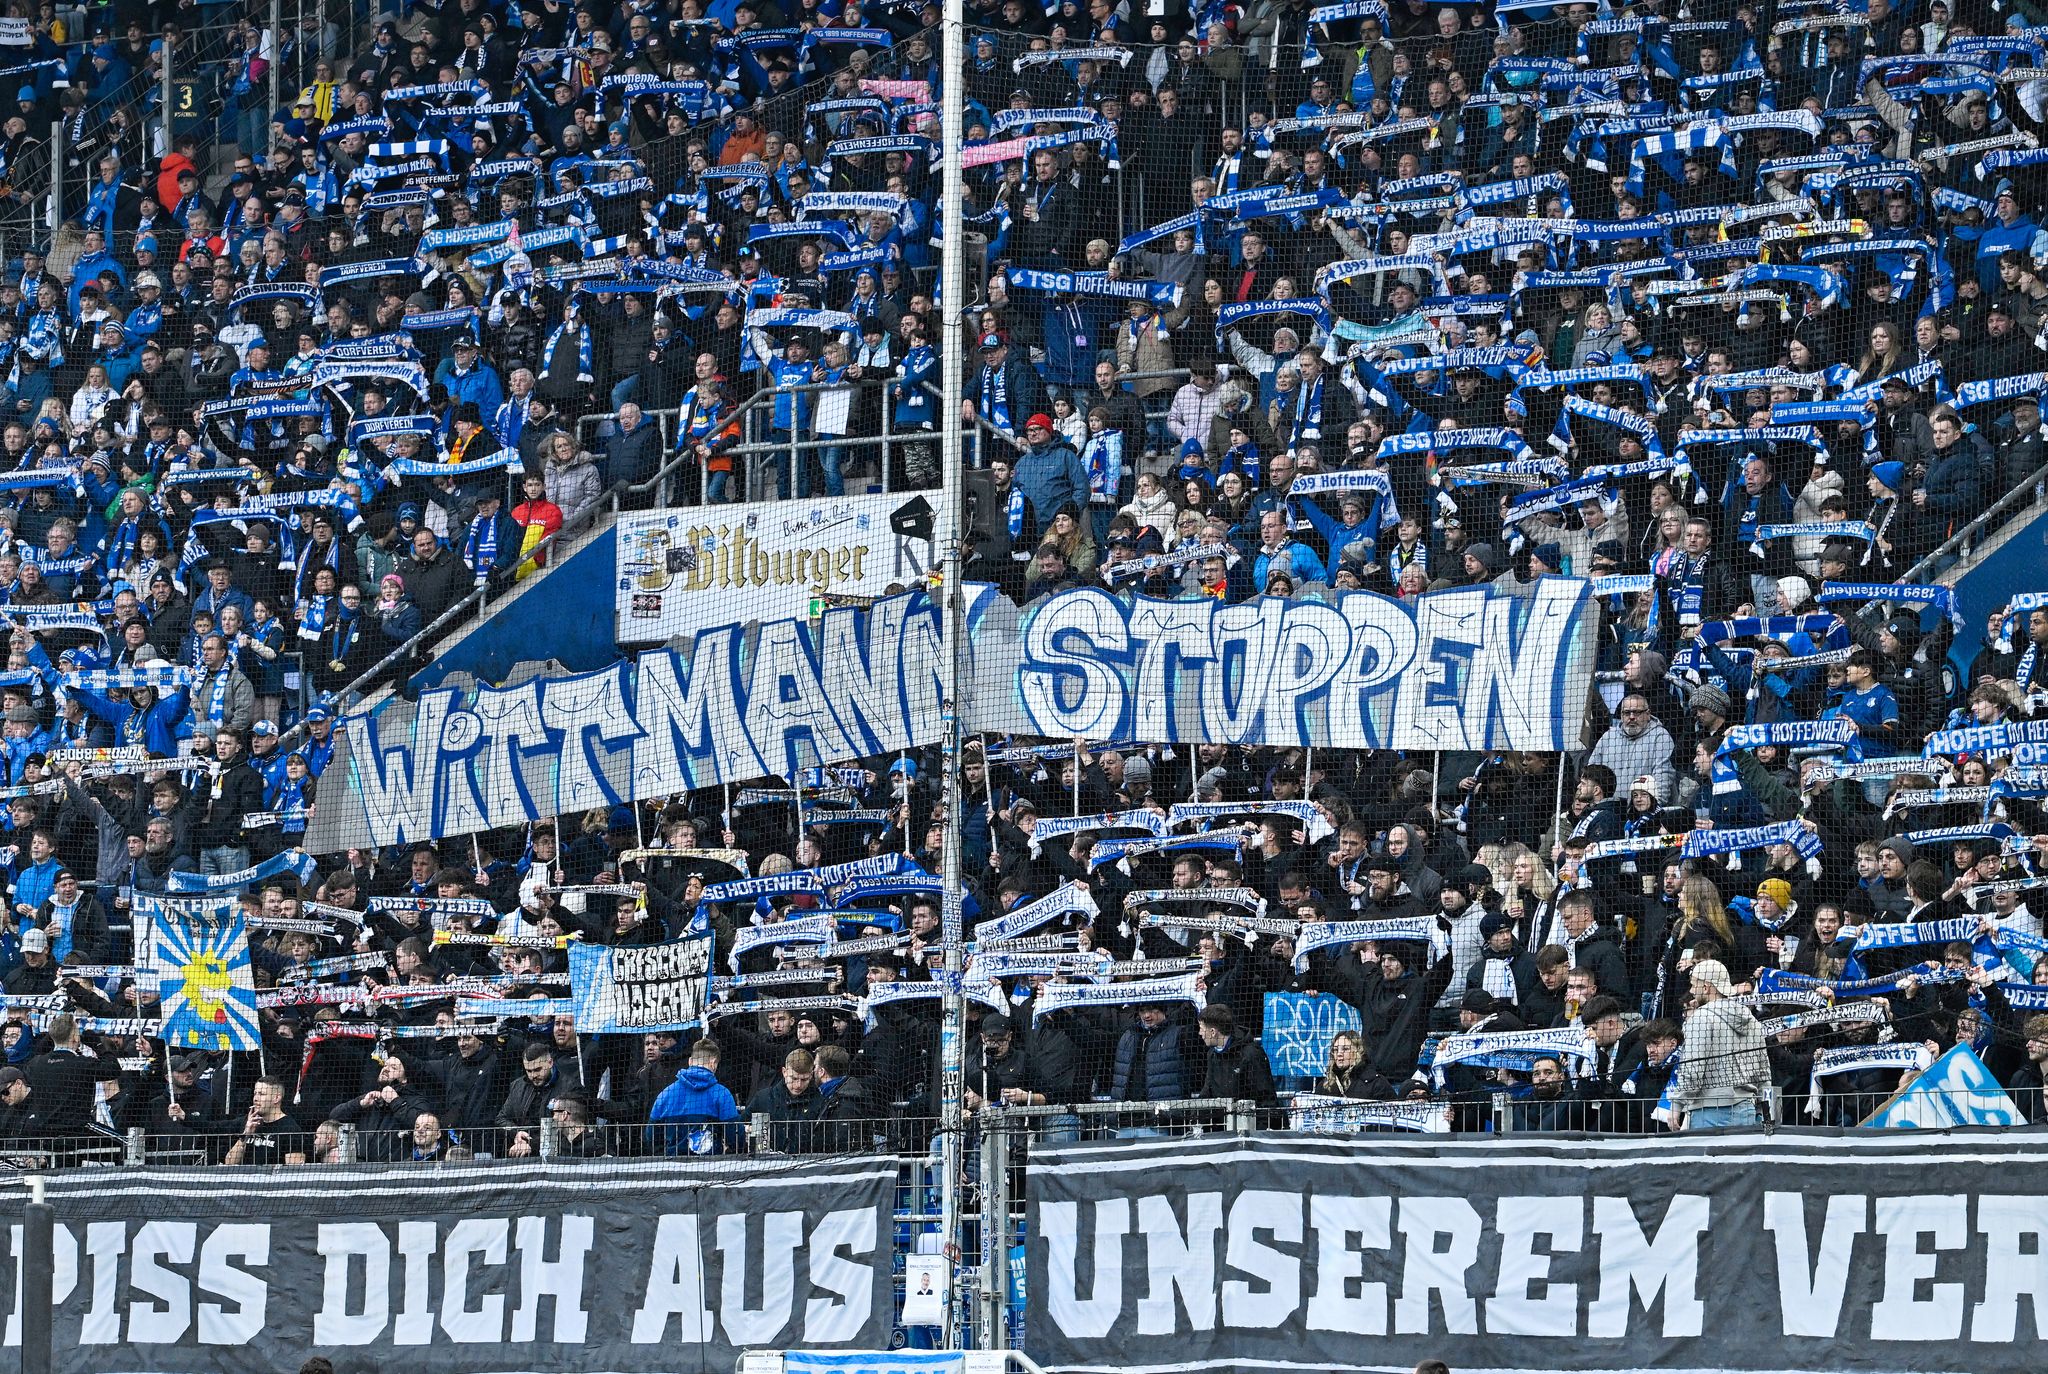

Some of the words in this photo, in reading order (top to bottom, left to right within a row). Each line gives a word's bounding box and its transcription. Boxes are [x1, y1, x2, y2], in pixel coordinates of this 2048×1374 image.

[0, 22, 29, 31] ITTMANN
[179, 85, 193, 110] 3
[835, 138, 896, 152] HOFFENHEIM
[340, 261, 387, 276] DORFVEREIN
[1336, 259, 1369, 277] 1899
[1027, 270, 1072, 291] TSG
[1074, 276, 1148, 300] HOFFENHEIM
[336, 343, 397, 357] DORFVEREIN
[314, 364, 341, 382] 1899
[1553, 363, 1644, 384] HOFFENHEIM
[364, 419, 414, 433] DORFVEREIN
[1391, 432, 1430, 452] TSG
[1433, 428, 1500, 449] HOFFENHEIM
[1292, 478, 1318, 492] 899
[683, 521, 869, 594] Bitburger
[1902, 584, 1936, 600] 1899
[1018, 573, 1594, 752] STOPPEN
[1771, 718, 1853, 743] HOFFENHEIM
[1934, 728, 2006, 756] HOFFE
[1907, 824, 1992, 841] DORFVEREIN
[1917, 919, 1940, 942] IM
[984, 931, 1064, 951] HOFFENHEIM
[1039, 1190, 1710, 1339] UNSEREM
[3, 1221, 271, 1346] PISS
[314, 1214, 594, 1346] DICH
[630, 1206, 878, 1347] AUS
